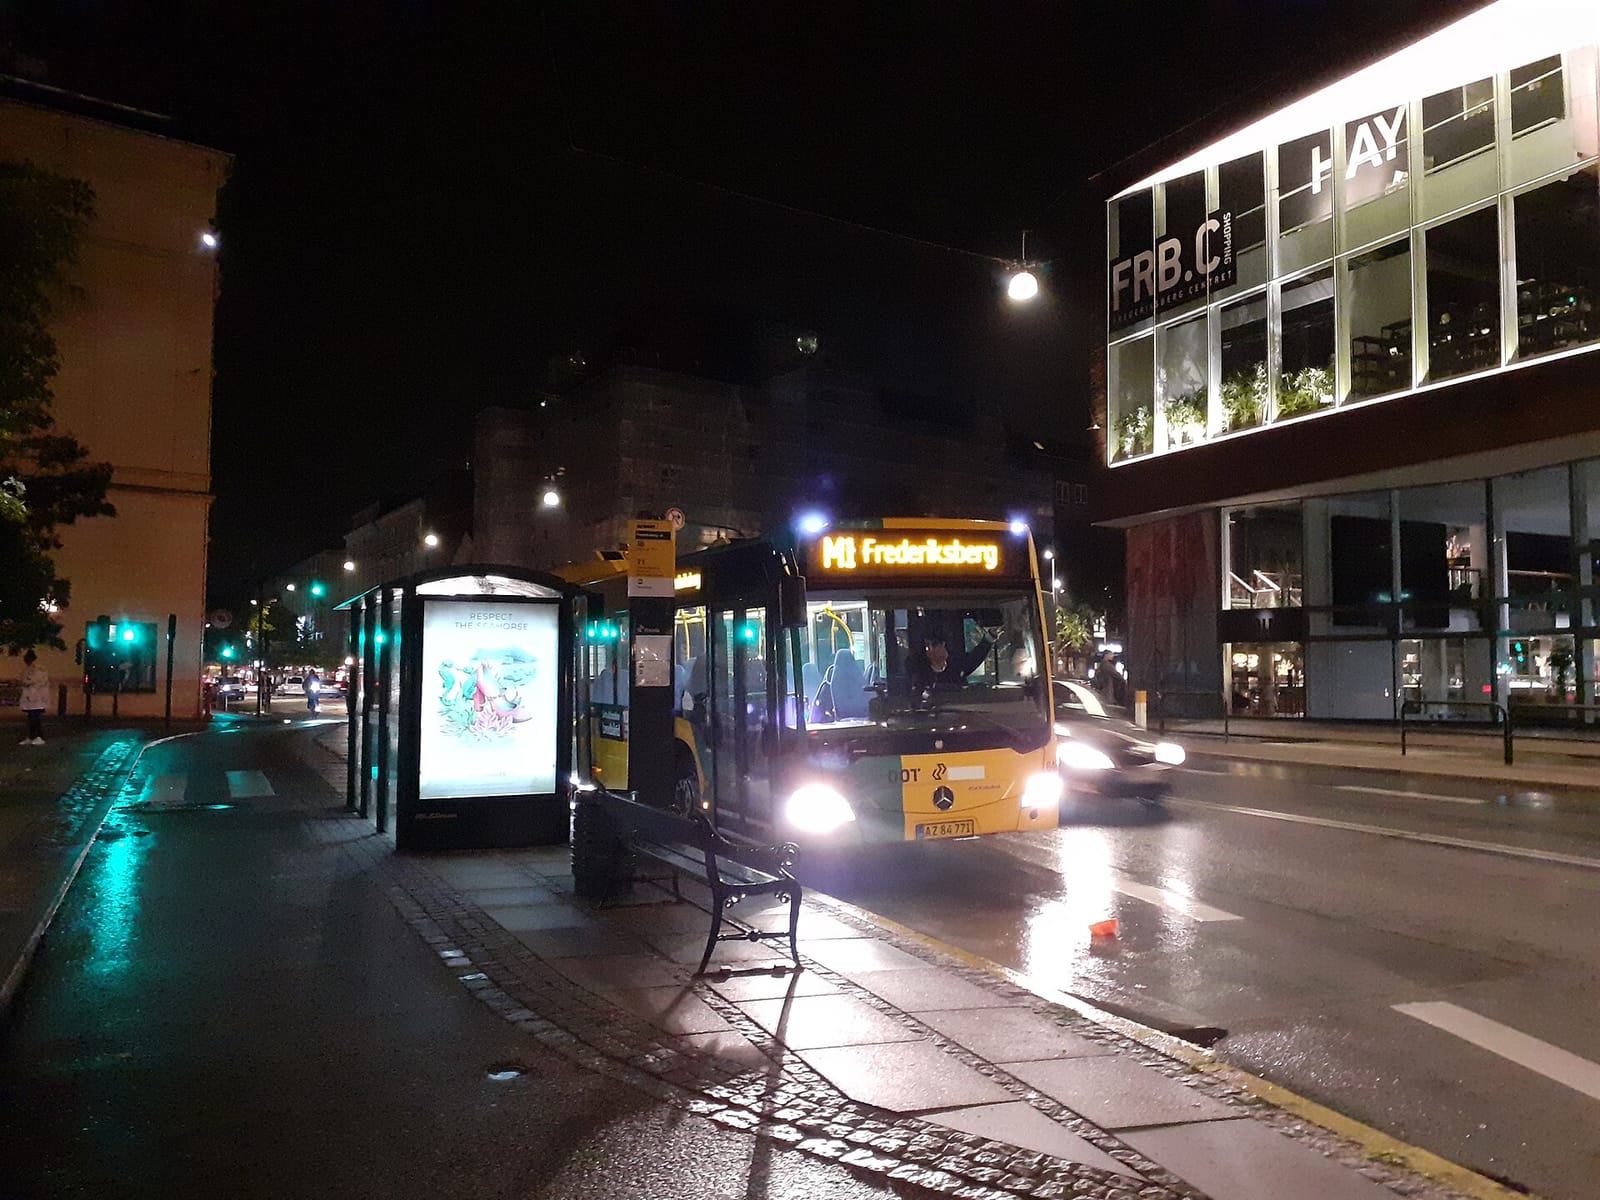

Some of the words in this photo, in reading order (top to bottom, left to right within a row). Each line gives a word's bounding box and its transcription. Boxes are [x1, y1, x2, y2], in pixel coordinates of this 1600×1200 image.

[1312, 105, 1406, 195] HAY
[1223, 211, 1232, 265] SHOPPING
[1112, 218, 1221, 312] FRB.C
[1188, 270, 1232, 295] CENTRET
[862, 538, 998, 570] Frederiksberg
[455, 621, 473, 630] THE
[469, 612, 513, 621] RESPECT
[925, 824, 937, 836] AZ
[940, 823, 953, 836] 84
[954, 822, 971, 834] 771
